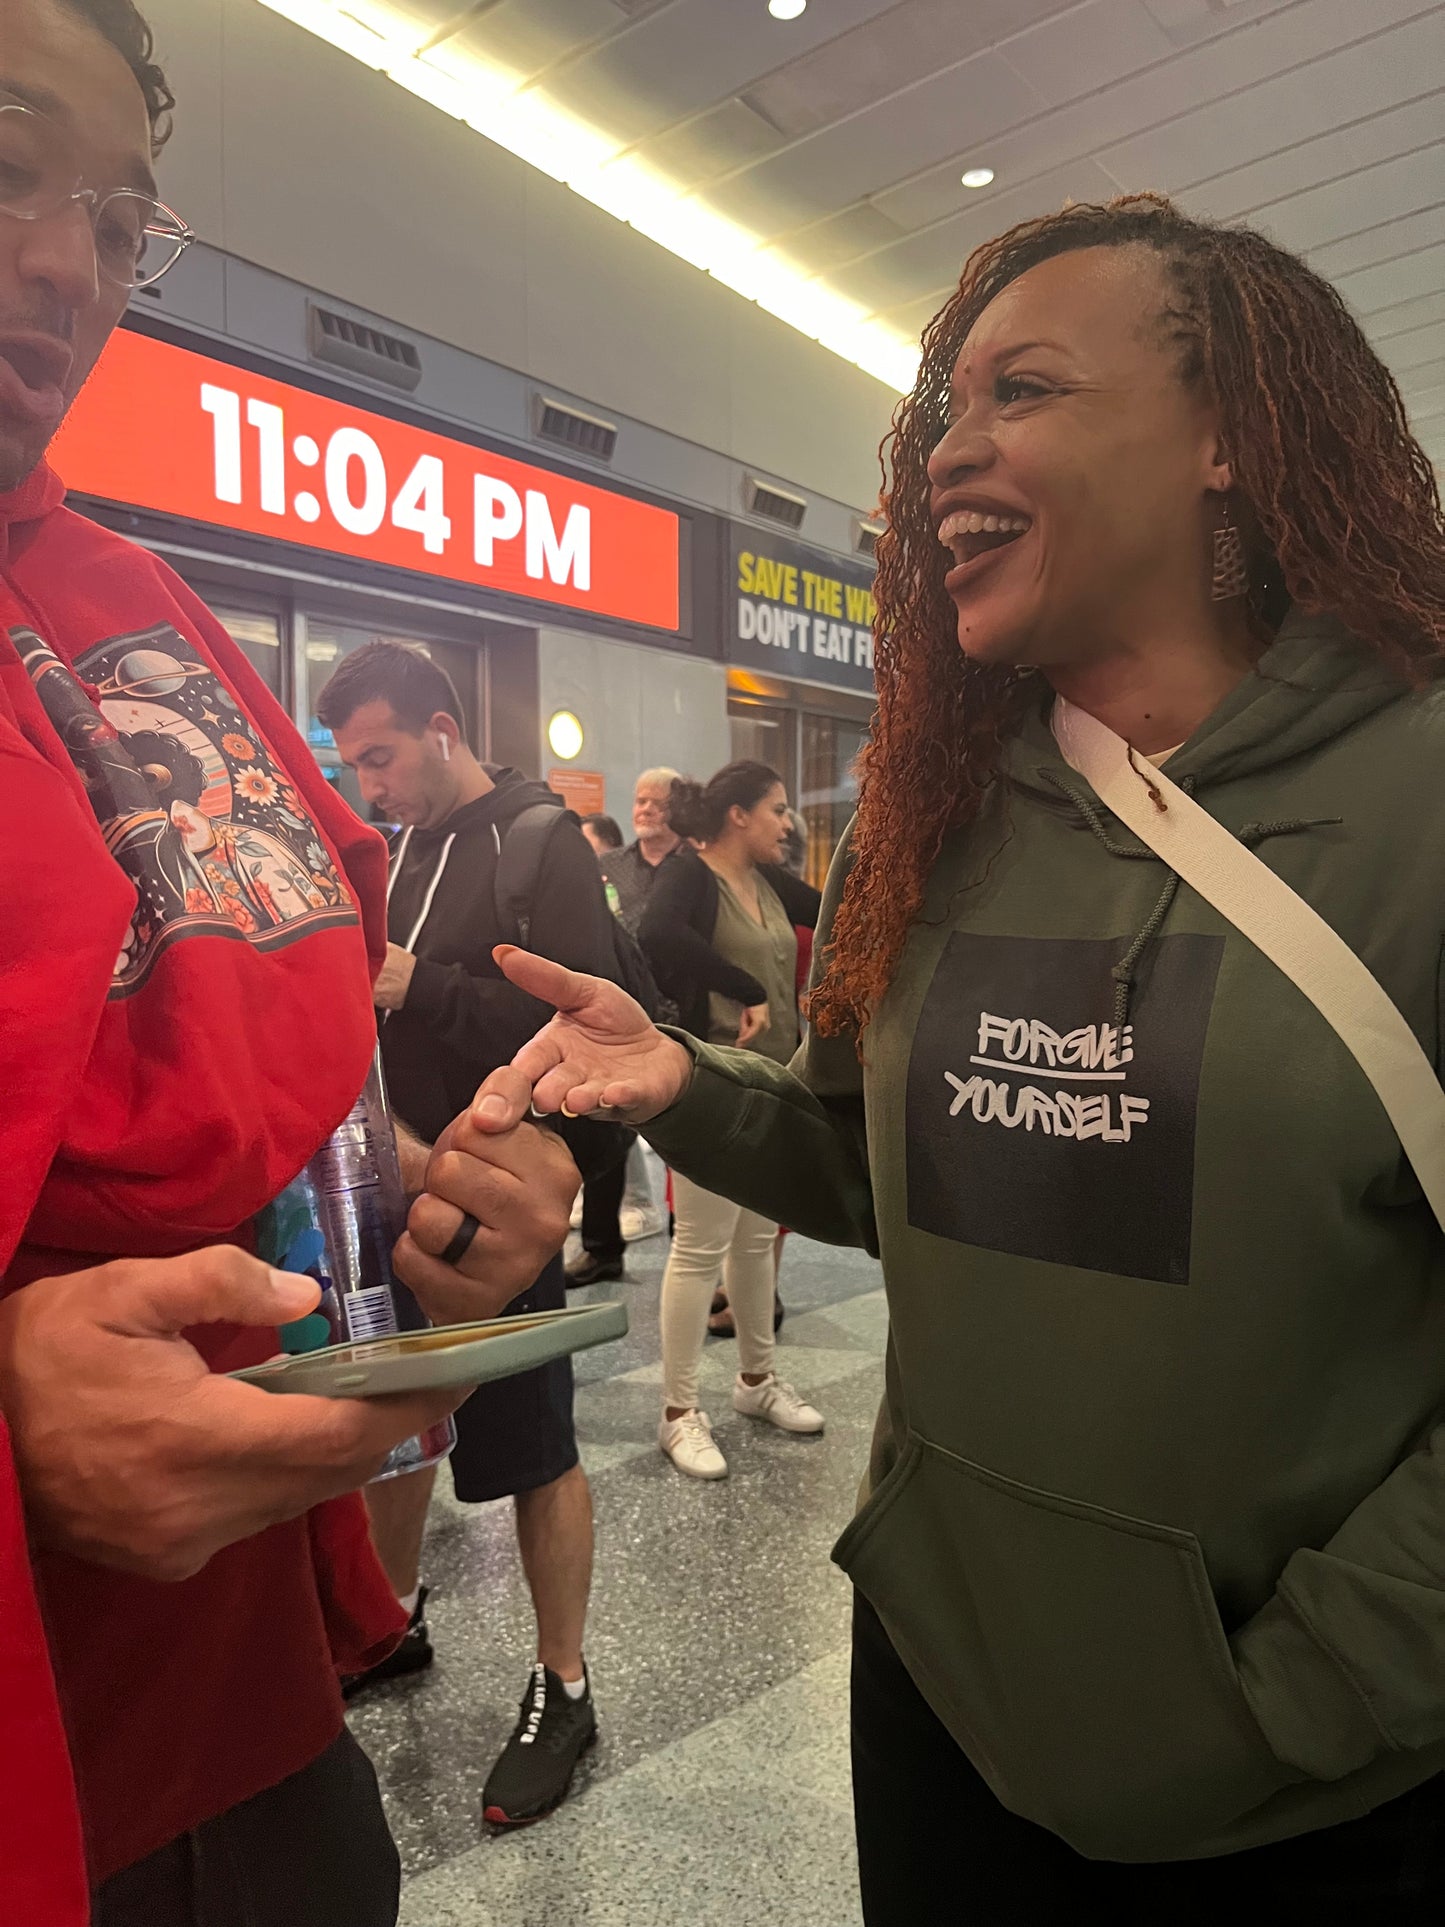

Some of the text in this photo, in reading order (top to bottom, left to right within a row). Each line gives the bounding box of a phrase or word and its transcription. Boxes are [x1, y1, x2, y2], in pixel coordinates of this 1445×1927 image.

[201, 382, 591, 591] 11:04 PM
[738, 551, 877, 627] SAVE THE WH
[738, 598, 810, 653] DON'T
[813, 618, 853, 664] EAT
[977, 1011, 1134, 1071] FORGIVE
[944, 1070, 1150, 1143] YOURSELF
